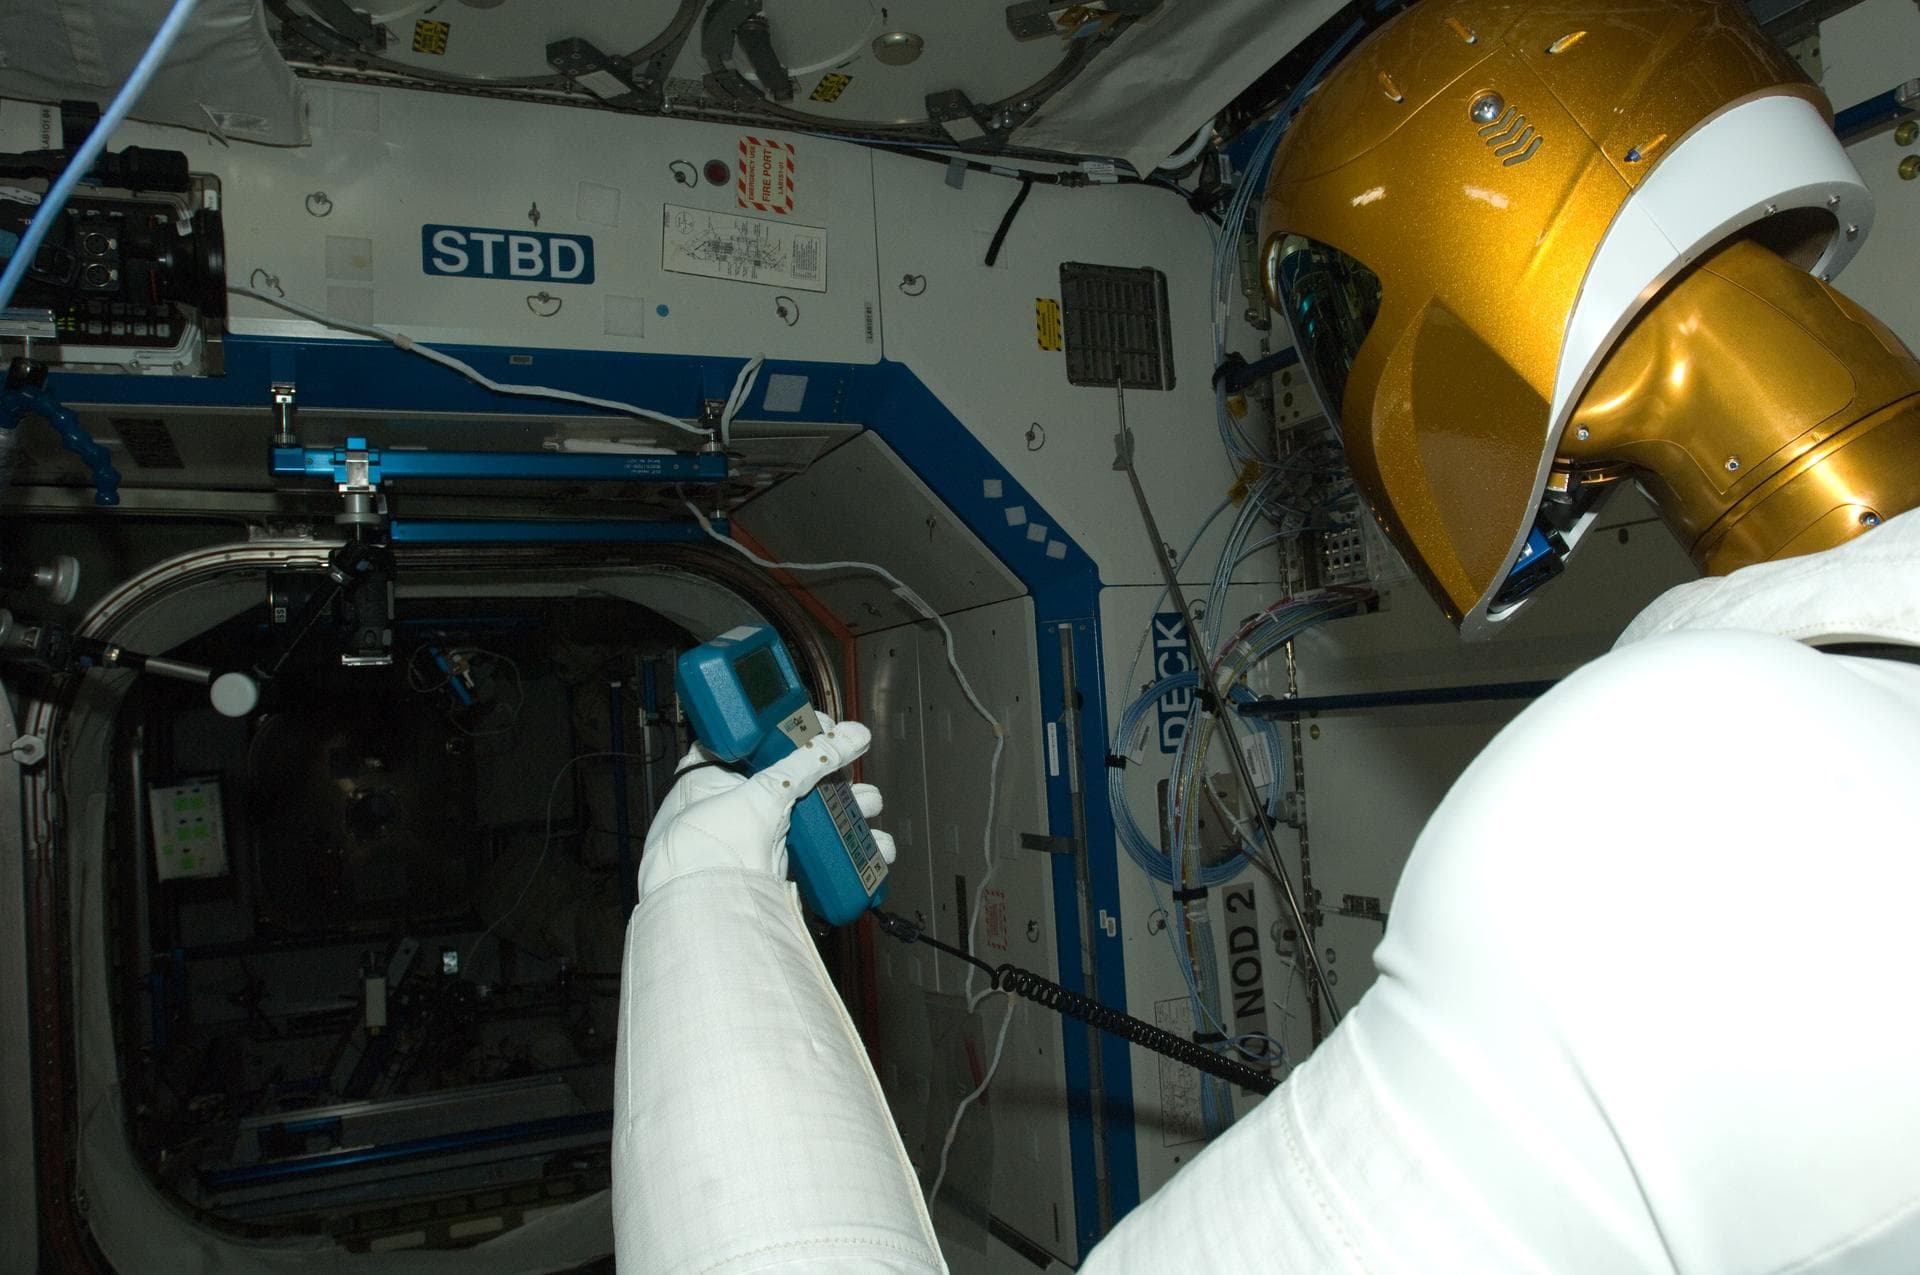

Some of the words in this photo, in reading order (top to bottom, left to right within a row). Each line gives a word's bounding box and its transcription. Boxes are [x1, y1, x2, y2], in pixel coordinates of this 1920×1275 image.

[748, 160, 756, 201] EMERGENCY
[763, 148, 772, 177] PORT
[762, 178, 771, 202] FIRE
[431, 229, 585, 280] STBD
[1154, 616, 1193, 748] DECK
[1226, 889, 1256, 914] 2
[1229, 926, 1265, 1019] NOD
